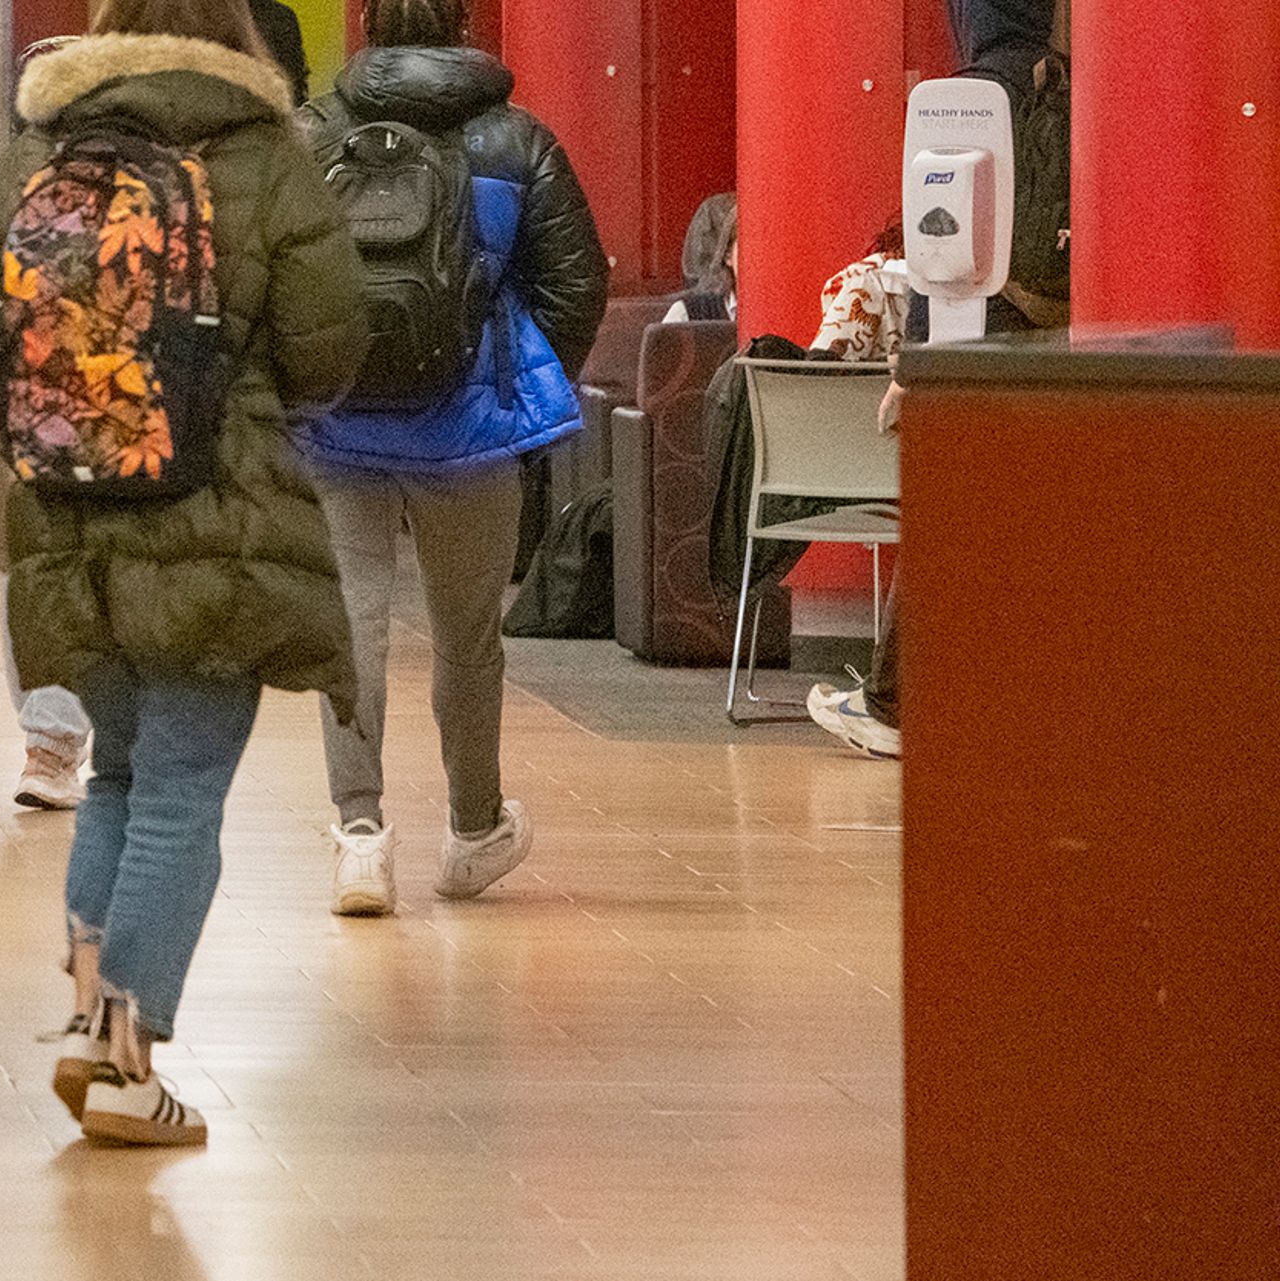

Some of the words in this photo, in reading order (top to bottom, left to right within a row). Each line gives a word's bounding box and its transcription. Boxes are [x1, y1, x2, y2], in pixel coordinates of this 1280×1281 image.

[918, 108, 958, 117] HEALTHY
[960, 108, 994, 117] HANDS
[922, 120, 957, 130] START
[960, 120, 989, 130] HERE
